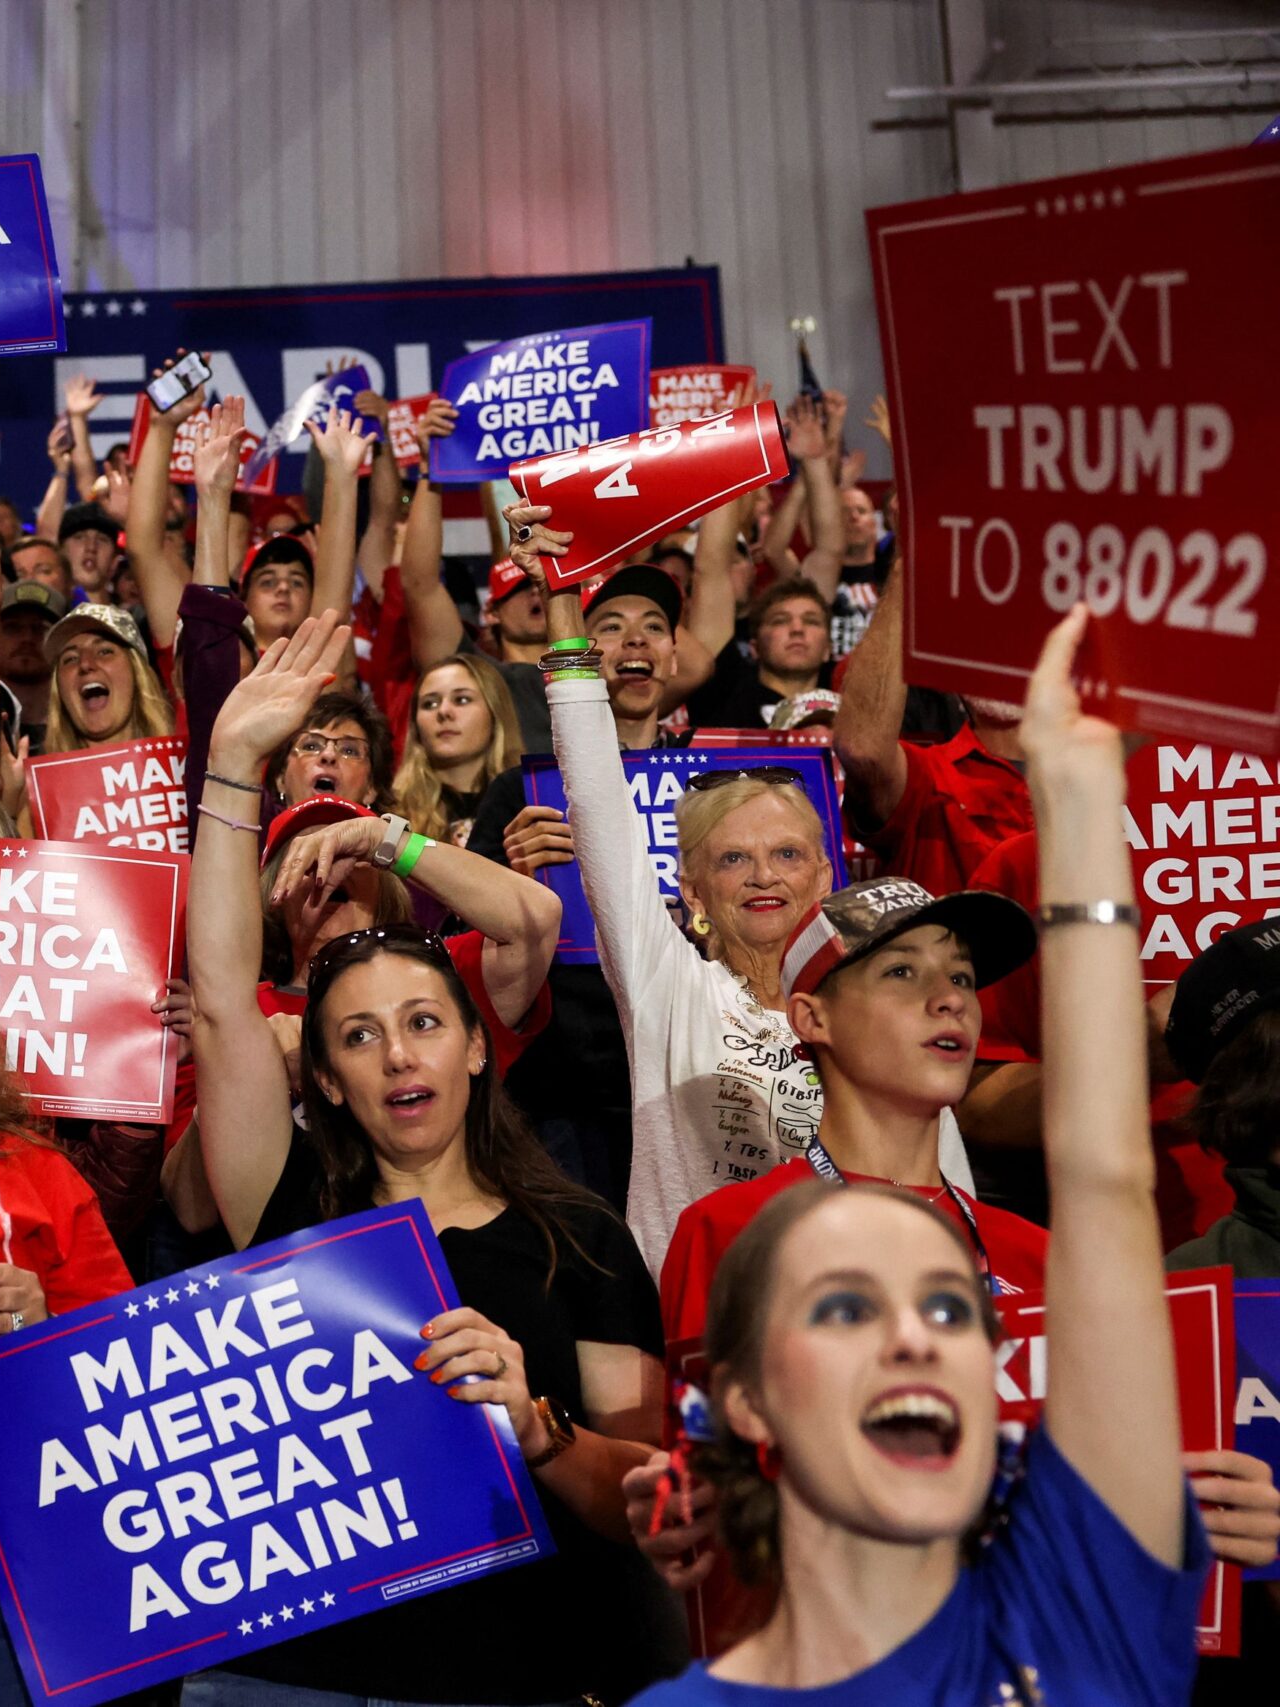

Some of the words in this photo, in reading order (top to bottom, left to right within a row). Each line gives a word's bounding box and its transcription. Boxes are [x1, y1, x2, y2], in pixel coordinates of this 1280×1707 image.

[994, 271, 1188, 375] TEXT
[489, 340, 590, 376] MAKE
[456, 363, 619, 406] AMERICA
[658, 373, 722, 390] MAKE
[477, 393, 596, 431] GREAT
[476, 421, 601, 461] AGAIN!
[974, 404, 1234, 497] TRUMP
[939, 515, 1019, 605] TO
[1042, 521, 1267, 638] 88022
[101, 755, 187, 797] MAK
[74, 791, 188, 839] AMER
[1143, 852, 1280, 905] GRE
[1211, 988, 1241, 1019] NEVER
[716, 1062, 764, 1084] Cinnamon
[777, 1079, 789, 1095] 6
[790, 1085, 824, 1101] TBSP
[740, 1143, 769, 1160] TBS
[788, 1127, 809, 1147] Cup
[728, 1163, 758, 1180] TBSP
[808, 1145, 843, 1183] RUMP
[69, 1278, 315, 1413] MAKE
[37, 1329, 414, 1508] AMERICA
[101, 1408, 374, 1554] GREAT
[128, 1477, 419, 1634] AGAIN!
